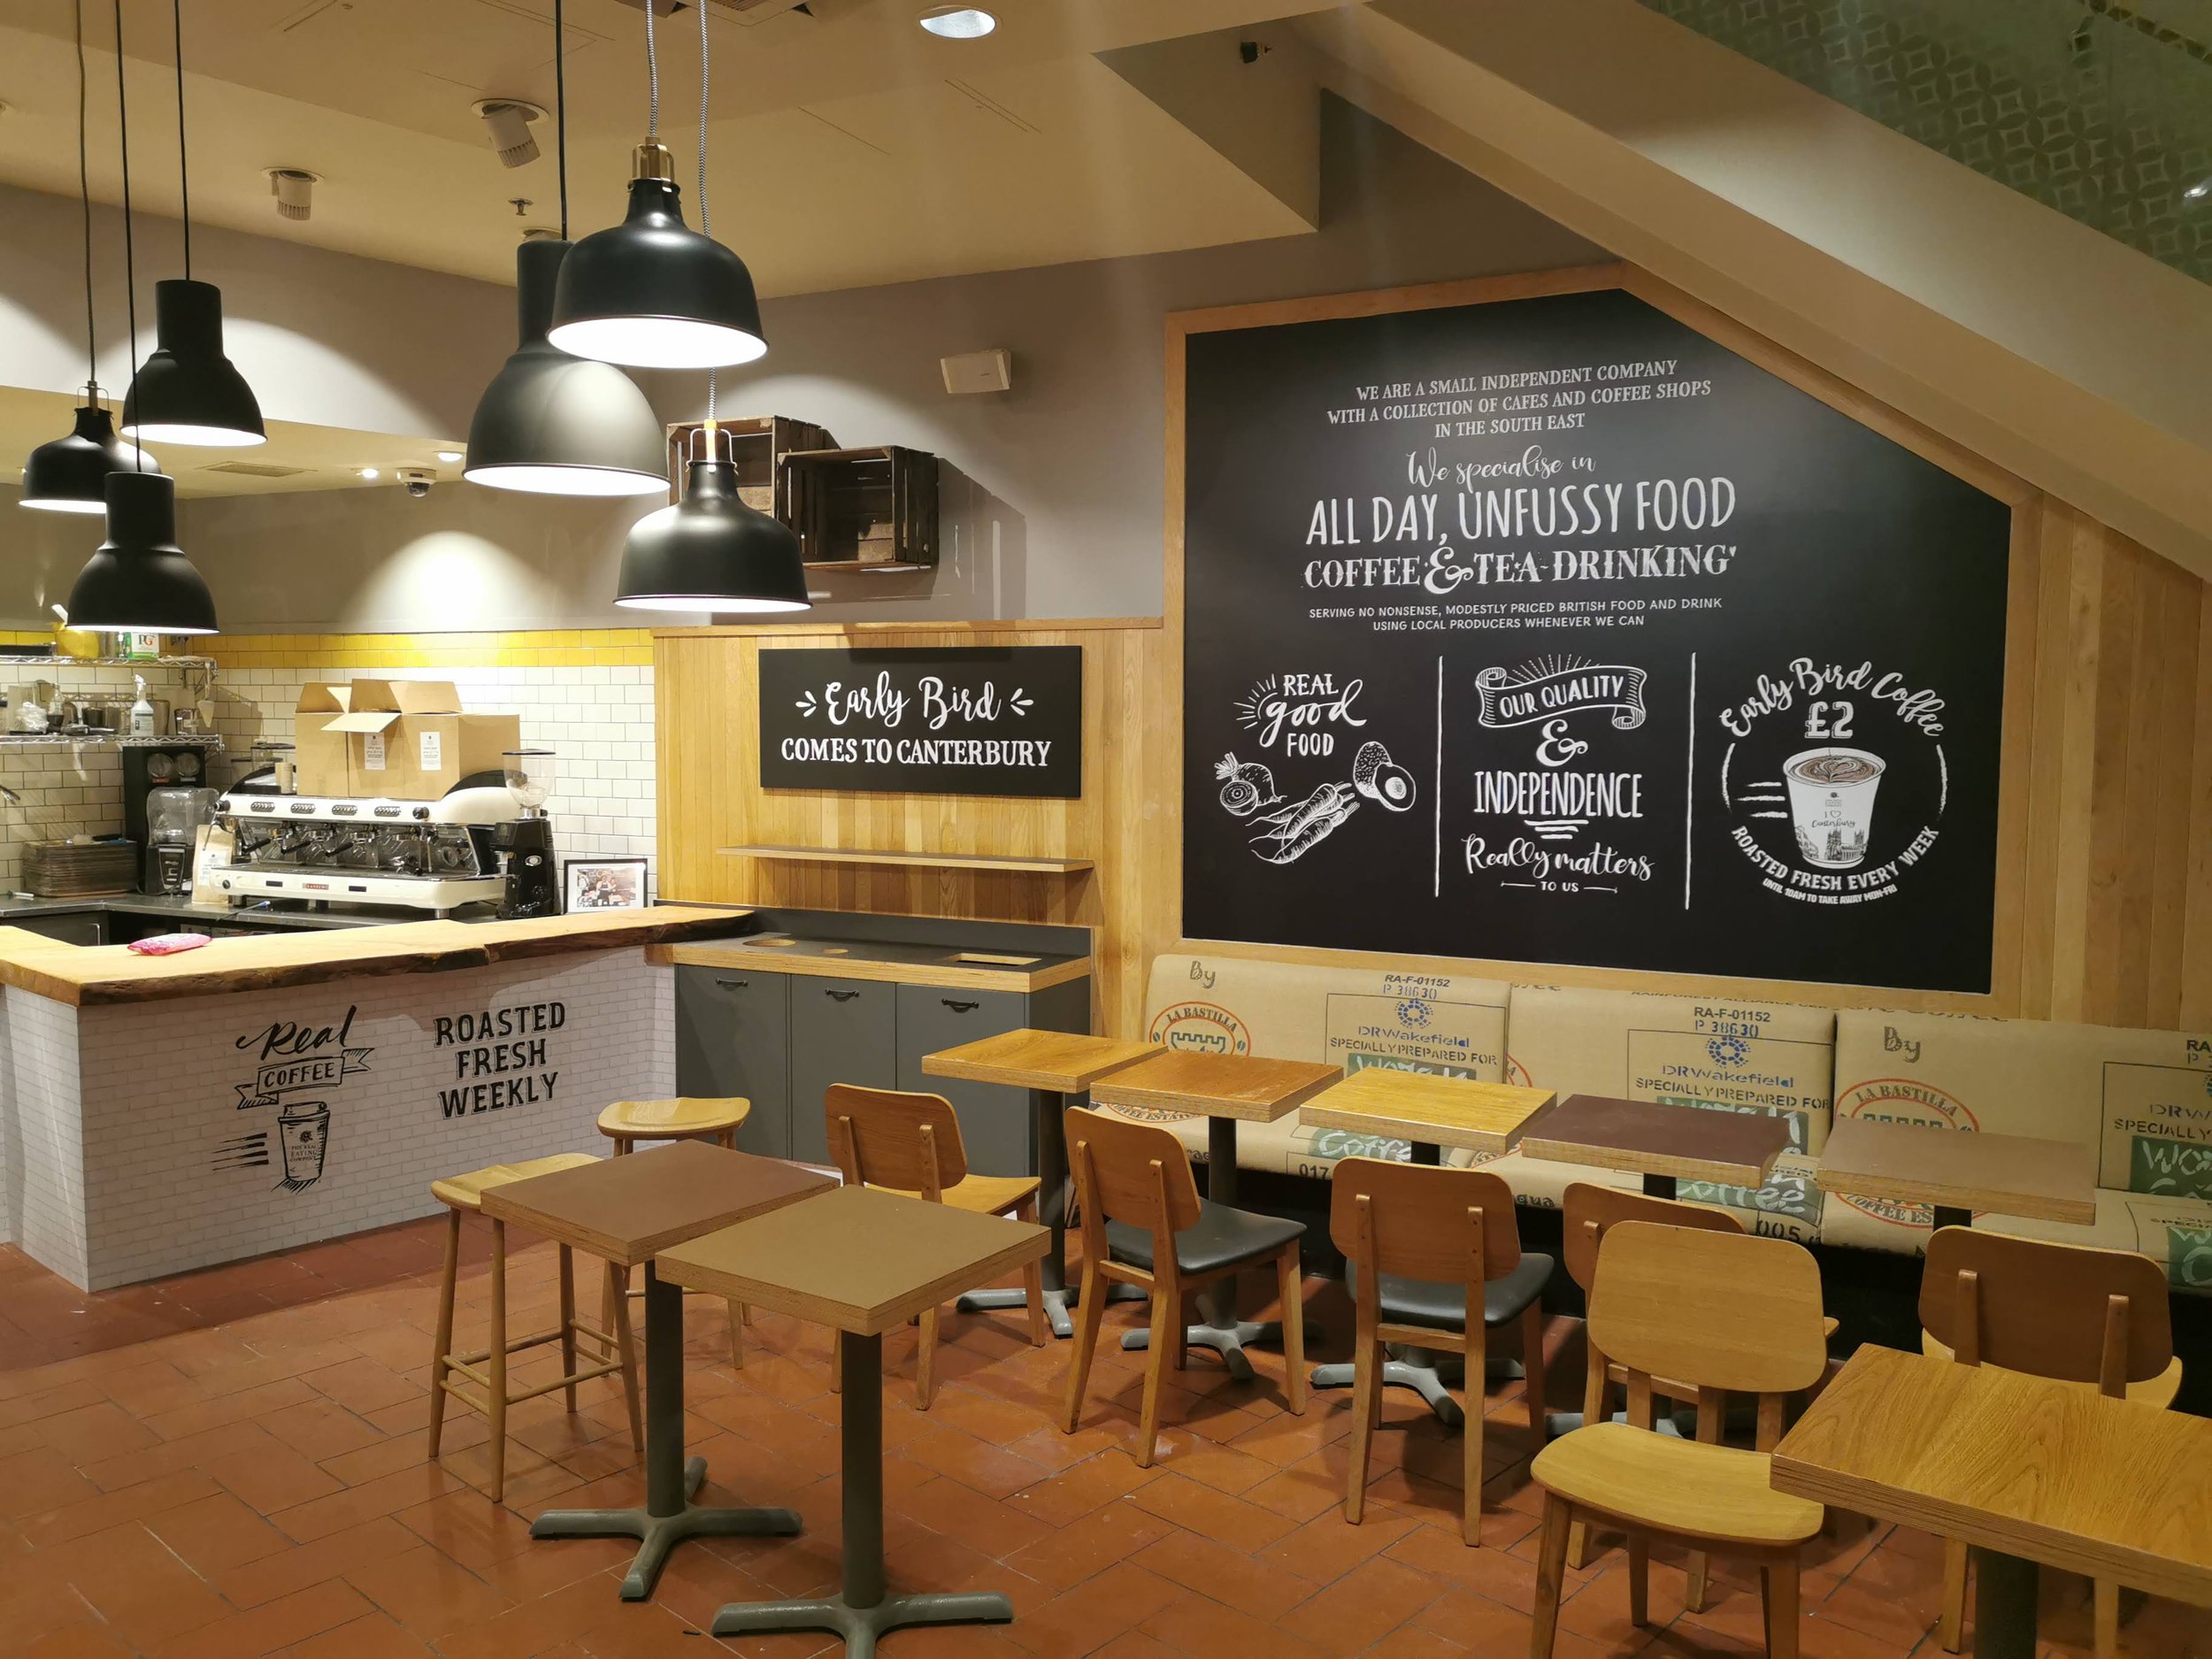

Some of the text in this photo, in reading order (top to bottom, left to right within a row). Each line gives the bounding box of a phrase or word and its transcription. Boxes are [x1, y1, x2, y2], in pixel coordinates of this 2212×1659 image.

[1356, 359, 1678, 401] WE ARE A SMALL INDEPENDENT COMPANY
[1327, 380, 1711, 424] WITH A COLLECTION OF CAFES AND COFFEE SHOPS
[1434, 413, 1586, 438] IN THE SOUTH EAST
[1406, 445, 1597, 493] We specialise in
[1305, 477, 1736, 546] ALL DAY, UNFUSSY FOOD
[1303, 544, 1729, 595] COFFEE & TEA DRINKING
[1309, 598, 1723, 618] SERVING NO NONSENSE, MODESTLY PRICED BRITISH FOOD AND DRINK
[1373, 616, 1646, 631] USING LOCAL PRODUCERS WHENEVER WE CAN
[825, 671, 1002, 730] Early Bird
[1282, 673, 1340, 697] REAL
[1501, 675, 1624, 718] OUR QUALITY
[1718, 657, 1946, 736] Early Bird Coffee
[1259, 679, 1367, 747] good
[1804, 701, 1855, 739] £2
[780, 738, 1052, 766] COMES TO CANTERBURY
[1286, 733, 1334, 757] FOOD
[1536, 719, 1589, 766] &
[1474, 771, 1643, 818] INDEPENDENCE
[1461, 833, 1655, 880] Really matters
[1732, 826, 1939, 891] ROASTED FRESH EVERY WEEK
[1540, 881, 1578, 892] TO US
[1762, 878, 1899, 904] UNTIL 10AM TO TAKE AWAY MON-FRI
[1189, 960, 1217, 989] By
[1384, 973, 1451, 988] RA-F-01152
[235, 1005, 357, 1061] Real
[433, 1001, 566, 1048] ROASTED
[1166, 1007, 1238, 1033] LA BASTILLA
[1694, 1006, 1771, 1023] RA-F-01152
[456, 1038, 547, 1080] FRESH
[1397, 1043, 1467, 1062] PREPARED
[1471, 1052, 1498, 1066] FOR
[1884, 1026, 1921, 1064] By
[264, 1062, 335, 1087] COFFEE
[439, 1071, 558, 1120] WEEKLY
[1715, 1087, 1798, 1107] PREPARED
[1855, 1085, 1959, 1118] LA BASTILLA
